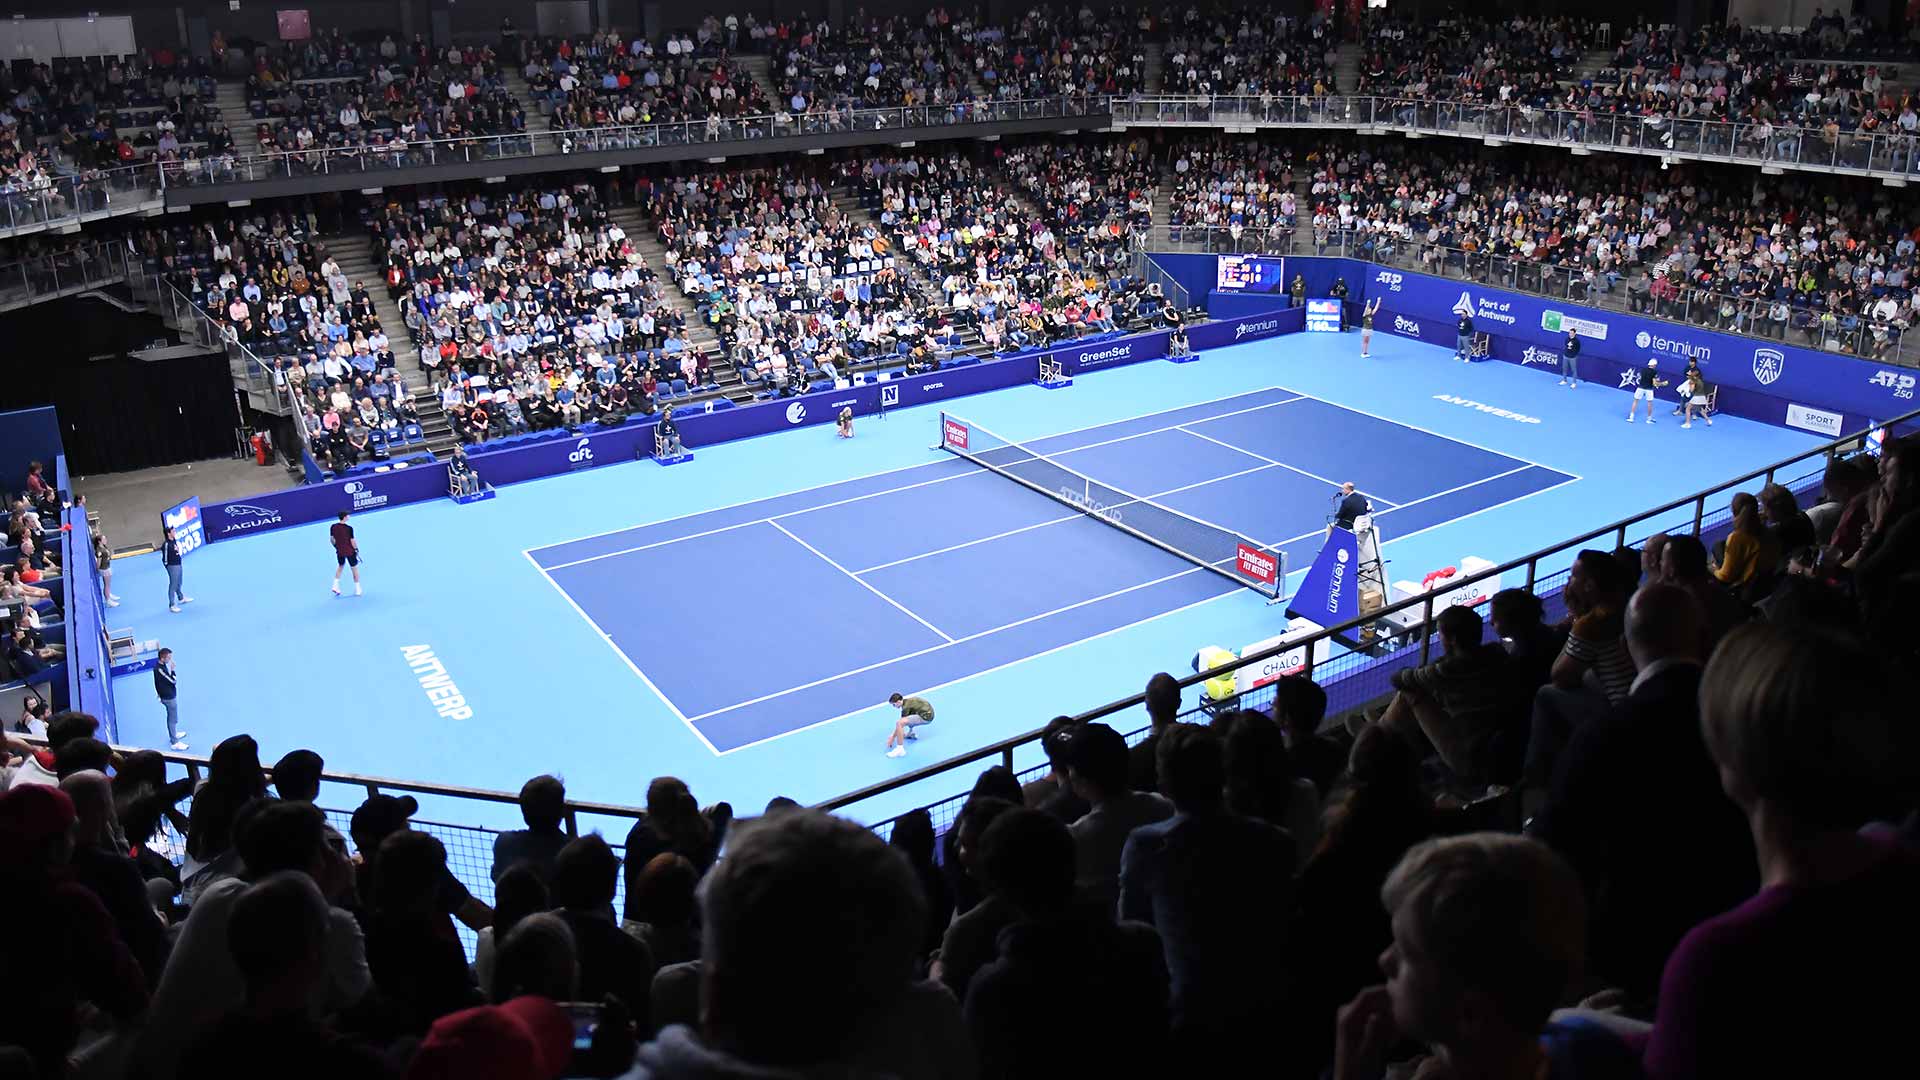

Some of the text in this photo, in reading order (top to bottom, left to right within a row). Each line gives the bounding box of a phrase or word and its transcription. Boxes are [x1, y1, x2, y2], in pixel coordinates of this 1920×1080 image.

[1376, 272, 1402, 284] ATP
[1479, 298, 1511, 312] Port of
[1477, 308, 1516, 325] Antwerp
[1079, 346, 1130, 363] GreenSet
[1652, 335, 1711, 361] tennium
[1536, 354, 1559, 366] OPEN
[1869, 370, 1916, 389] ATP
[1893, 388, 1913, 400] 250
[1432, 394, 1541, 423] ANTWERP
[1805, 412, 1835, 425] SPORT
[569, 447, 593, 462] aft
[222, 516, 282, 533] JAGUAR
[1239, 548, 1274, 572] Emirates
[1242, 560, 1268, 578] FLY BETTER
[1328, 563, 1346, 614] tennium
[1451, 588, 1479, 607] CHALO
[1263, 655, 1300, 676] CHALO
[399, 643, 474, 721] ANTWERP
